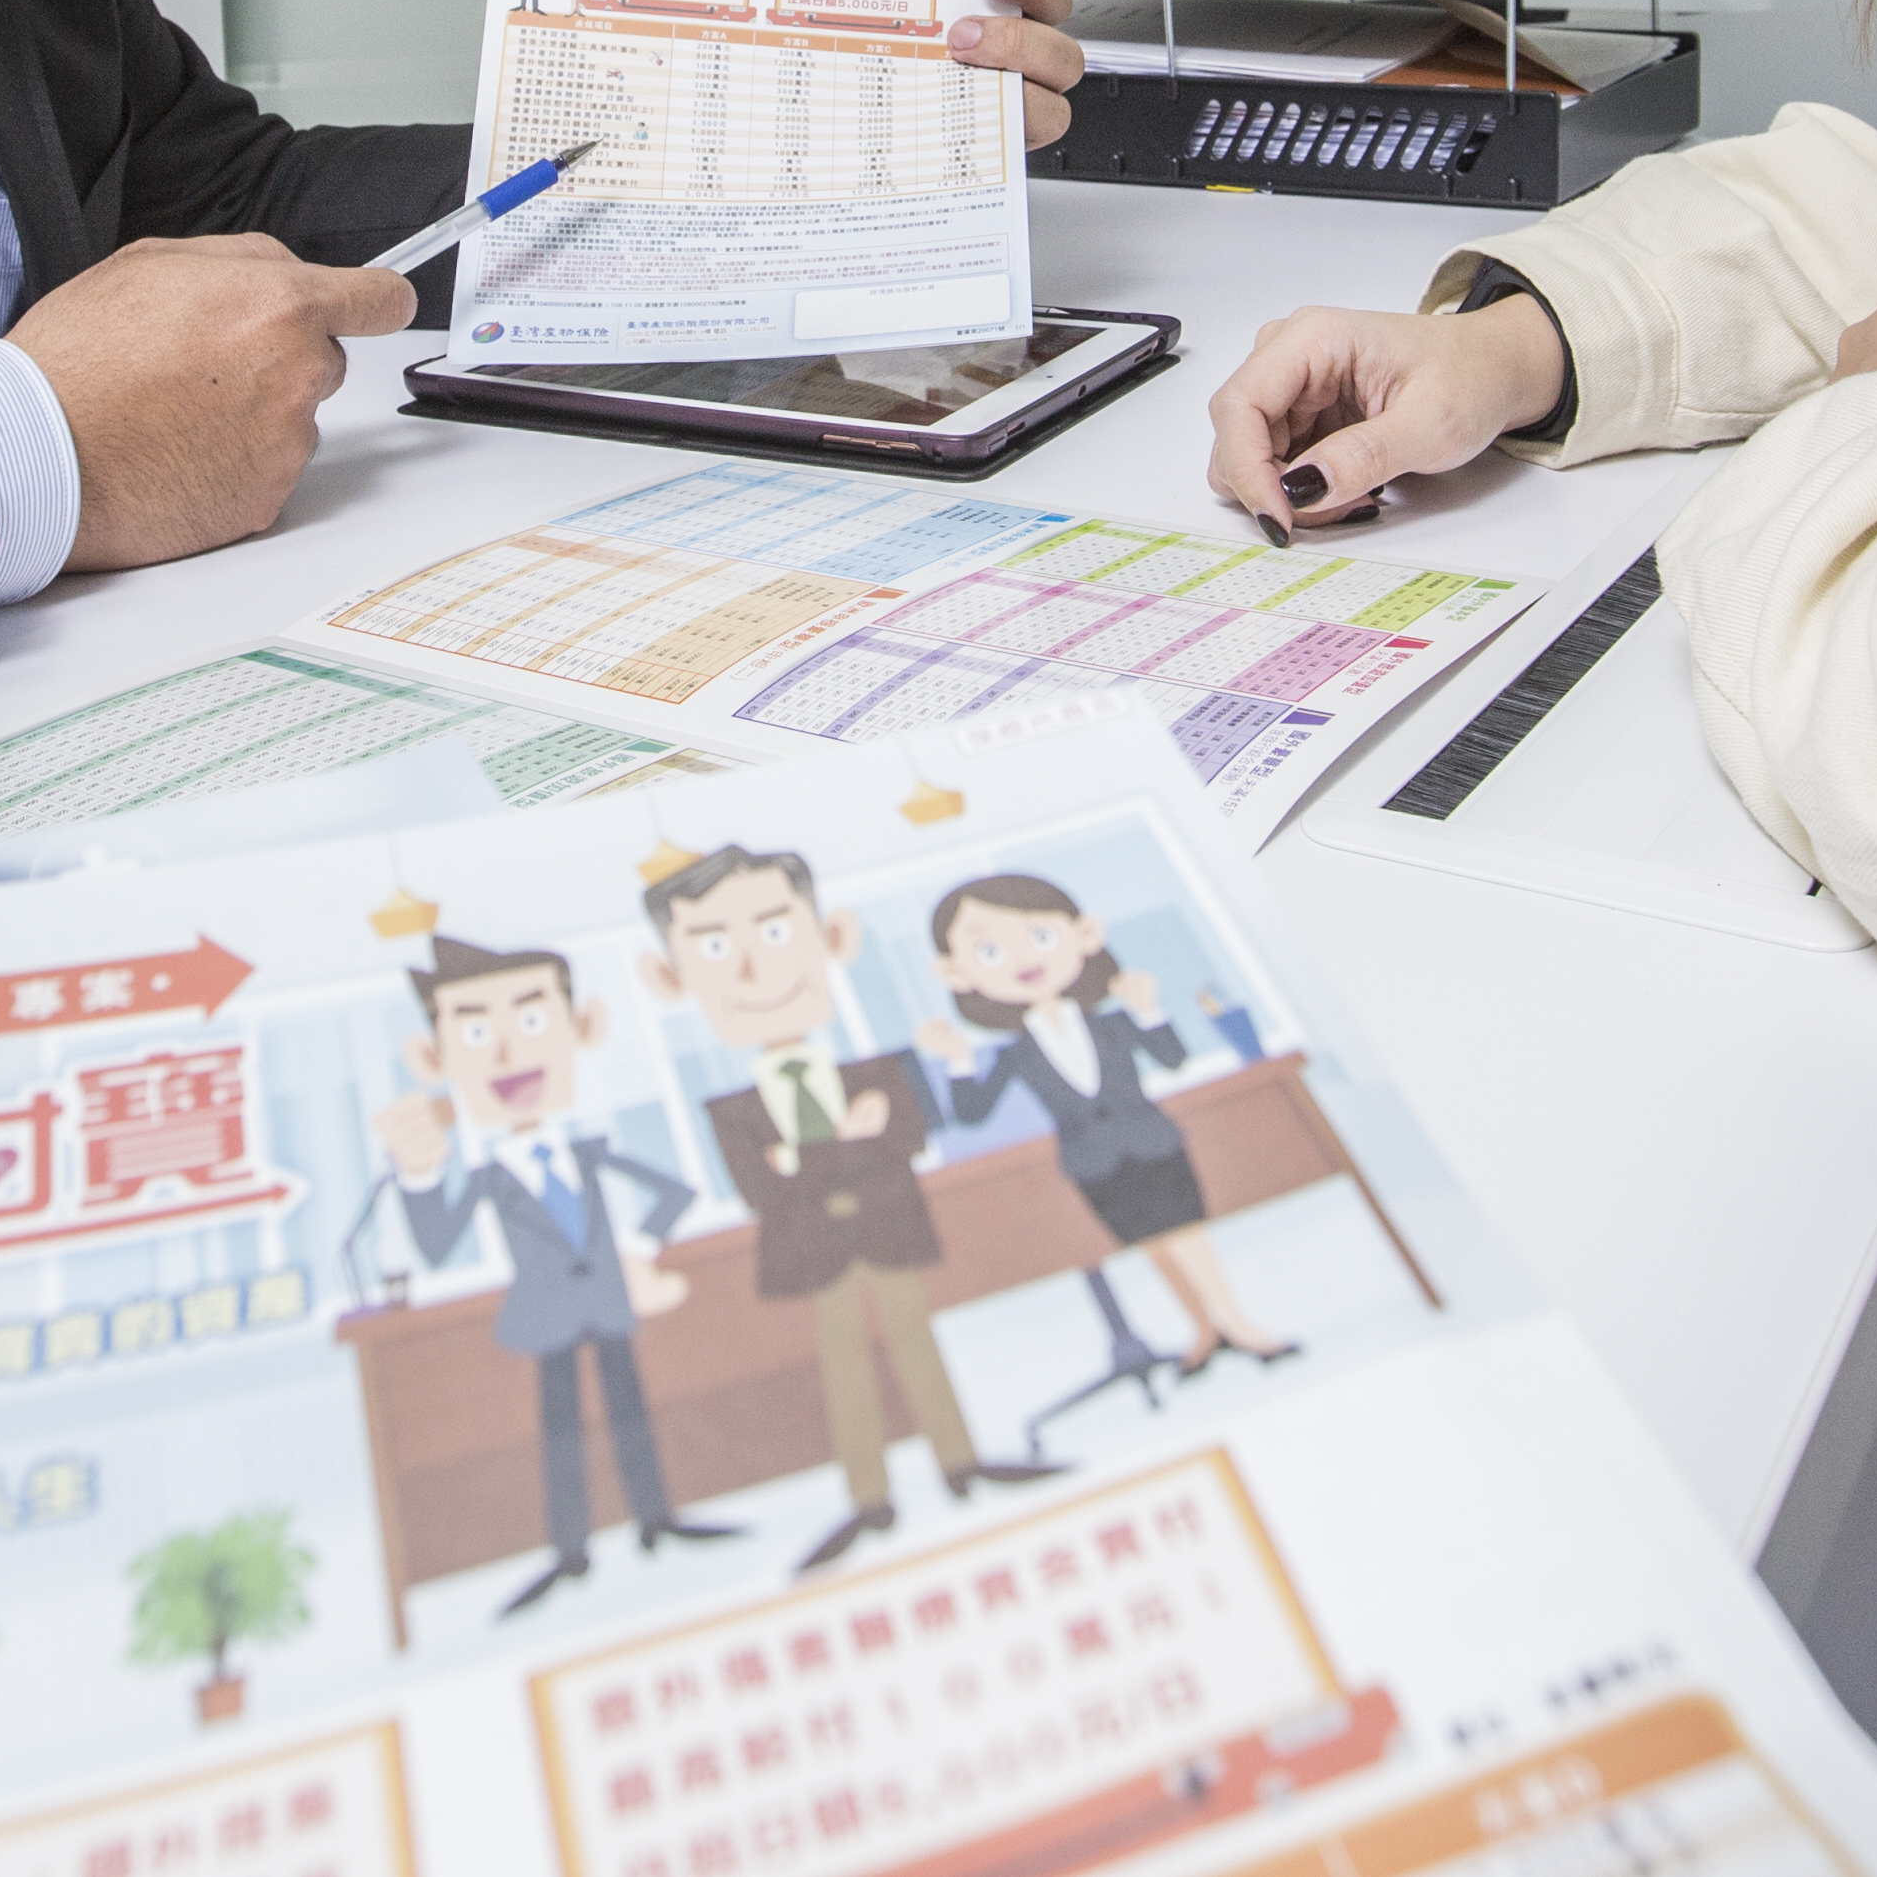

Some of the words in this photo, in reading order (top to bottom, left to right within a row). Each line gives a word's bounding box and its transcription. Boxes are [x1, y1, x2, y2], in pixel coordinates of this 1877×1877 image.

[701, 30, 727, 40] 方案A
[783, 37, 809, 46] 方案B
[866, 44, 891, 53] 方案C
[697, 43, 730, 52] 200萬元
[779, 50, 812, 59] 300萬元
[696, 53, 730, 62] 800萬元
[774, 60, 816, 68] 1,200萬元
[696, 63, 729, 71] 100萬元
[778, 70, 811, 78] 200萬元
[695, 73, 728, 81] 200萬元
[777, 79, 811, 87] 300萬元
[694, 83, 728, 91] 200萬元
[697, 92, 724, 100] 30萬元
[693, 101, 727, 109] 3,000元
[692, 120, 726, 128] 3,000元
[692, 129, 726, 137] 5,000元
[626, 317, 770, 329] 臺灣產物保險股份有限公司
[510, 325, 609, 337] 臺灣產物保險
[508, 753, 636, 810] 國外旅遊加值型
